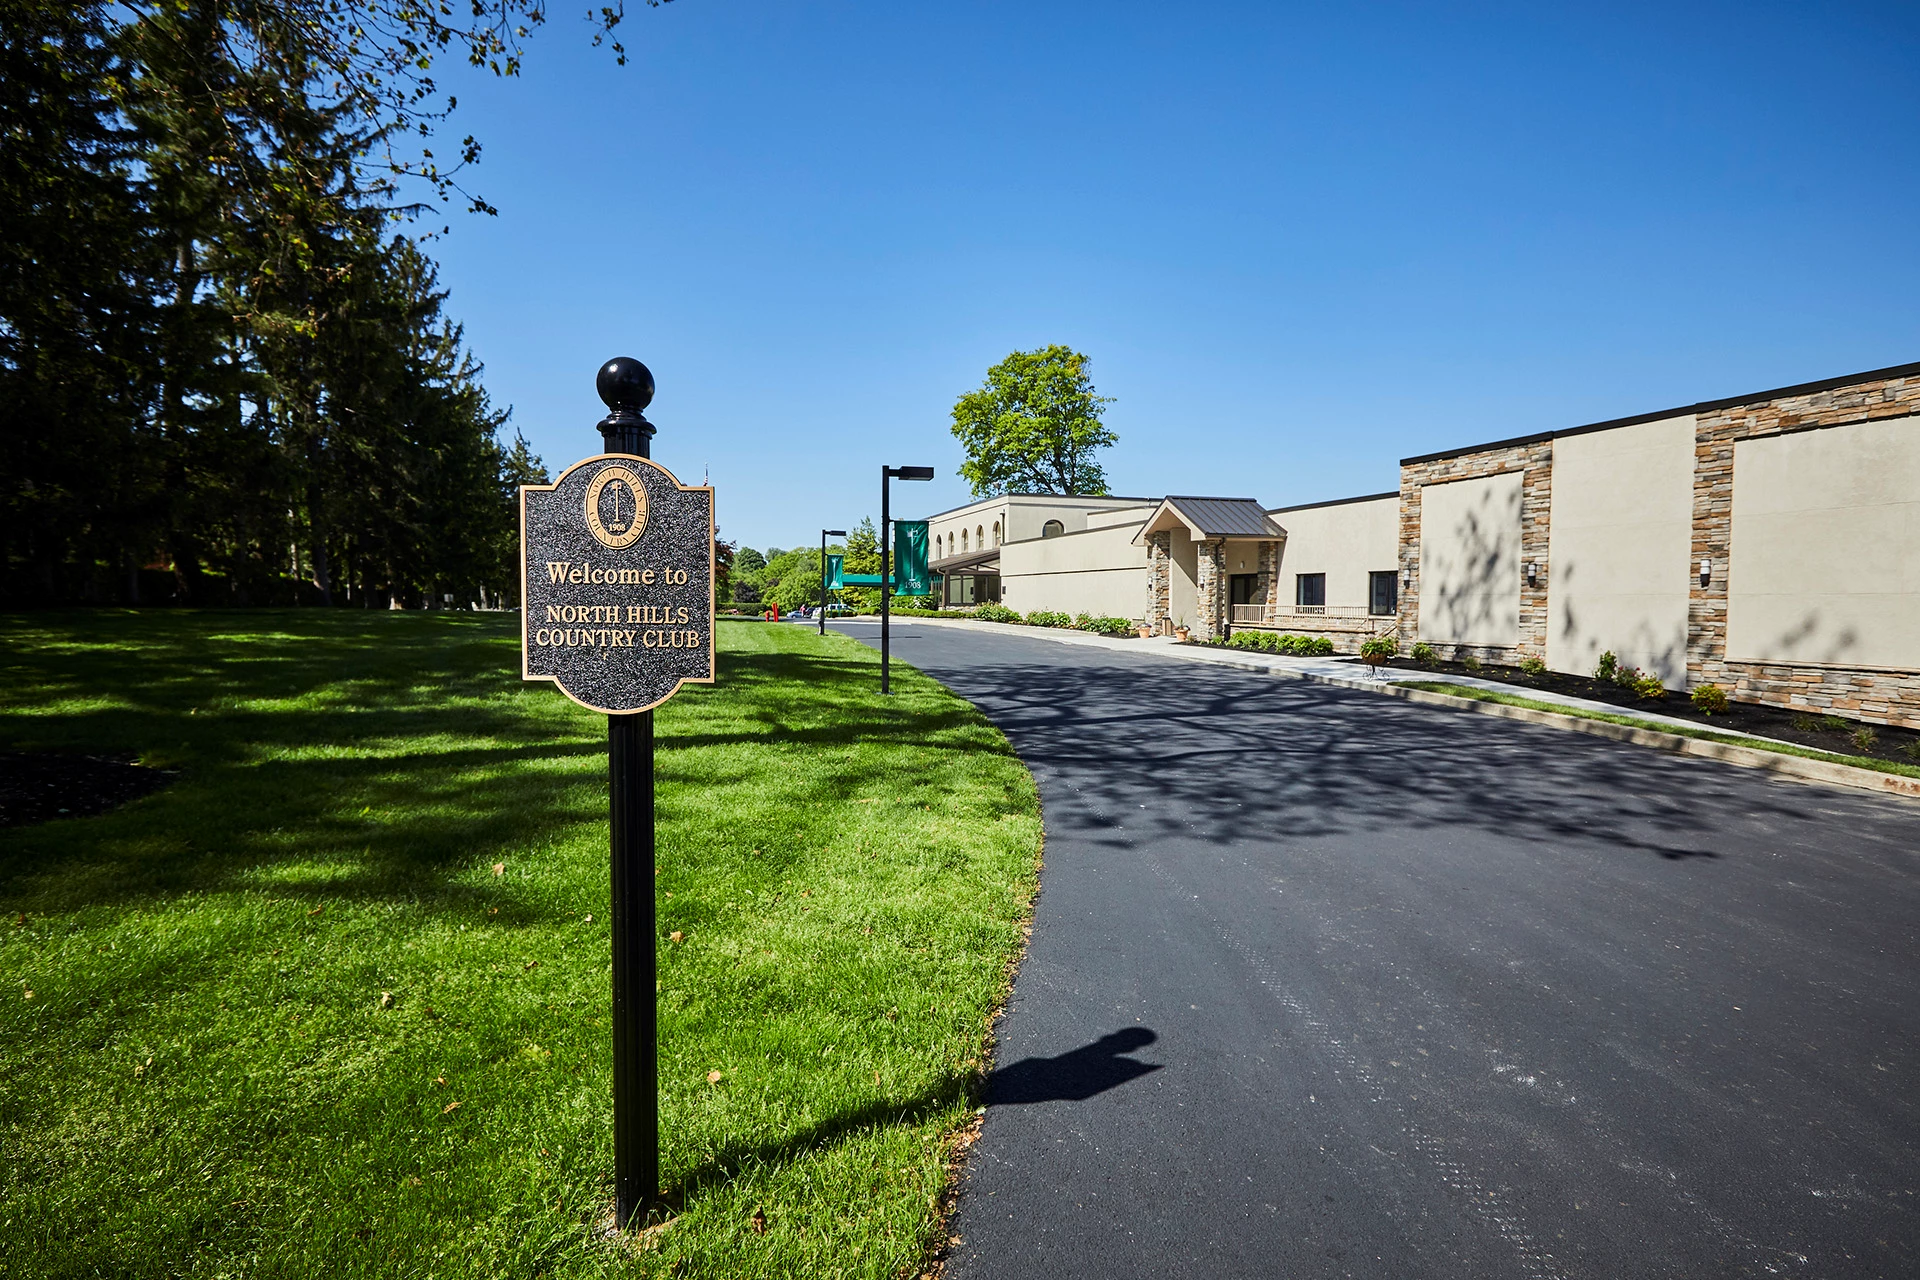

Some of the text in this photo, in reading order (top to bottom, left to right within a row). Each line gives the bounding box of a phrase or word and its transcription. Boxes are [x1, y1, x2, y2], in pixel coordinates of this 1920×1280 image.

[590, 469, 644, 503] NORTH HILLS
[589, 510, 646, 545] COUNTRY CLUB
[608, 523, 626, 532] 1908
[547, 562, 688, 585] Welcome to
[905, 581, 921, 589] 1908
[546, 605, 689, 625] NORTH HILLS
[536, 629, 700, 648] COUNTRY CLUB
